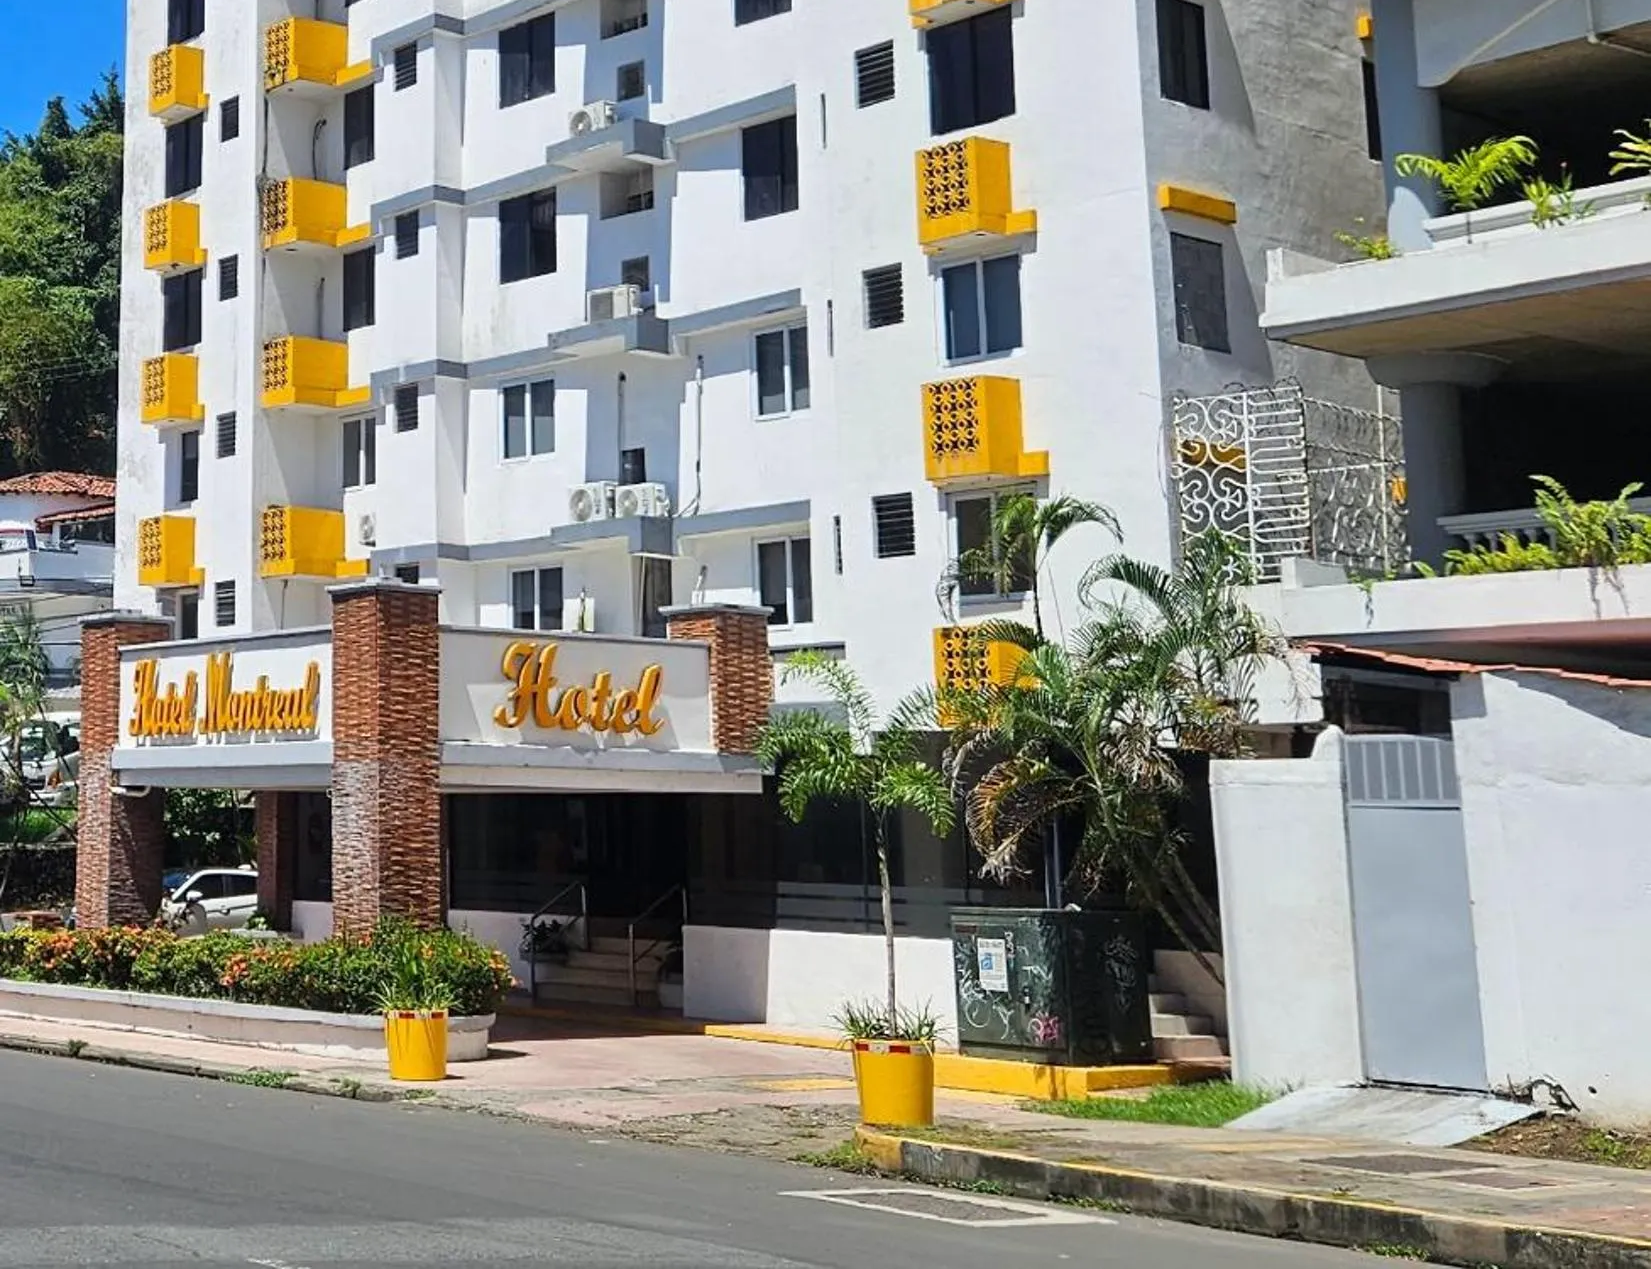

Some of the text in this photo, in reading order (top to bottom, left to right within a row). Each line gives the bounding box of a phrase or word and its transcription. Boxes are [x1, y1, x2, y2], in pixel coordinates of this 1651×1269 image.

[129, 651, 320, 737] Hotel Montreal
[494, 640, 664, 735] Hotel
